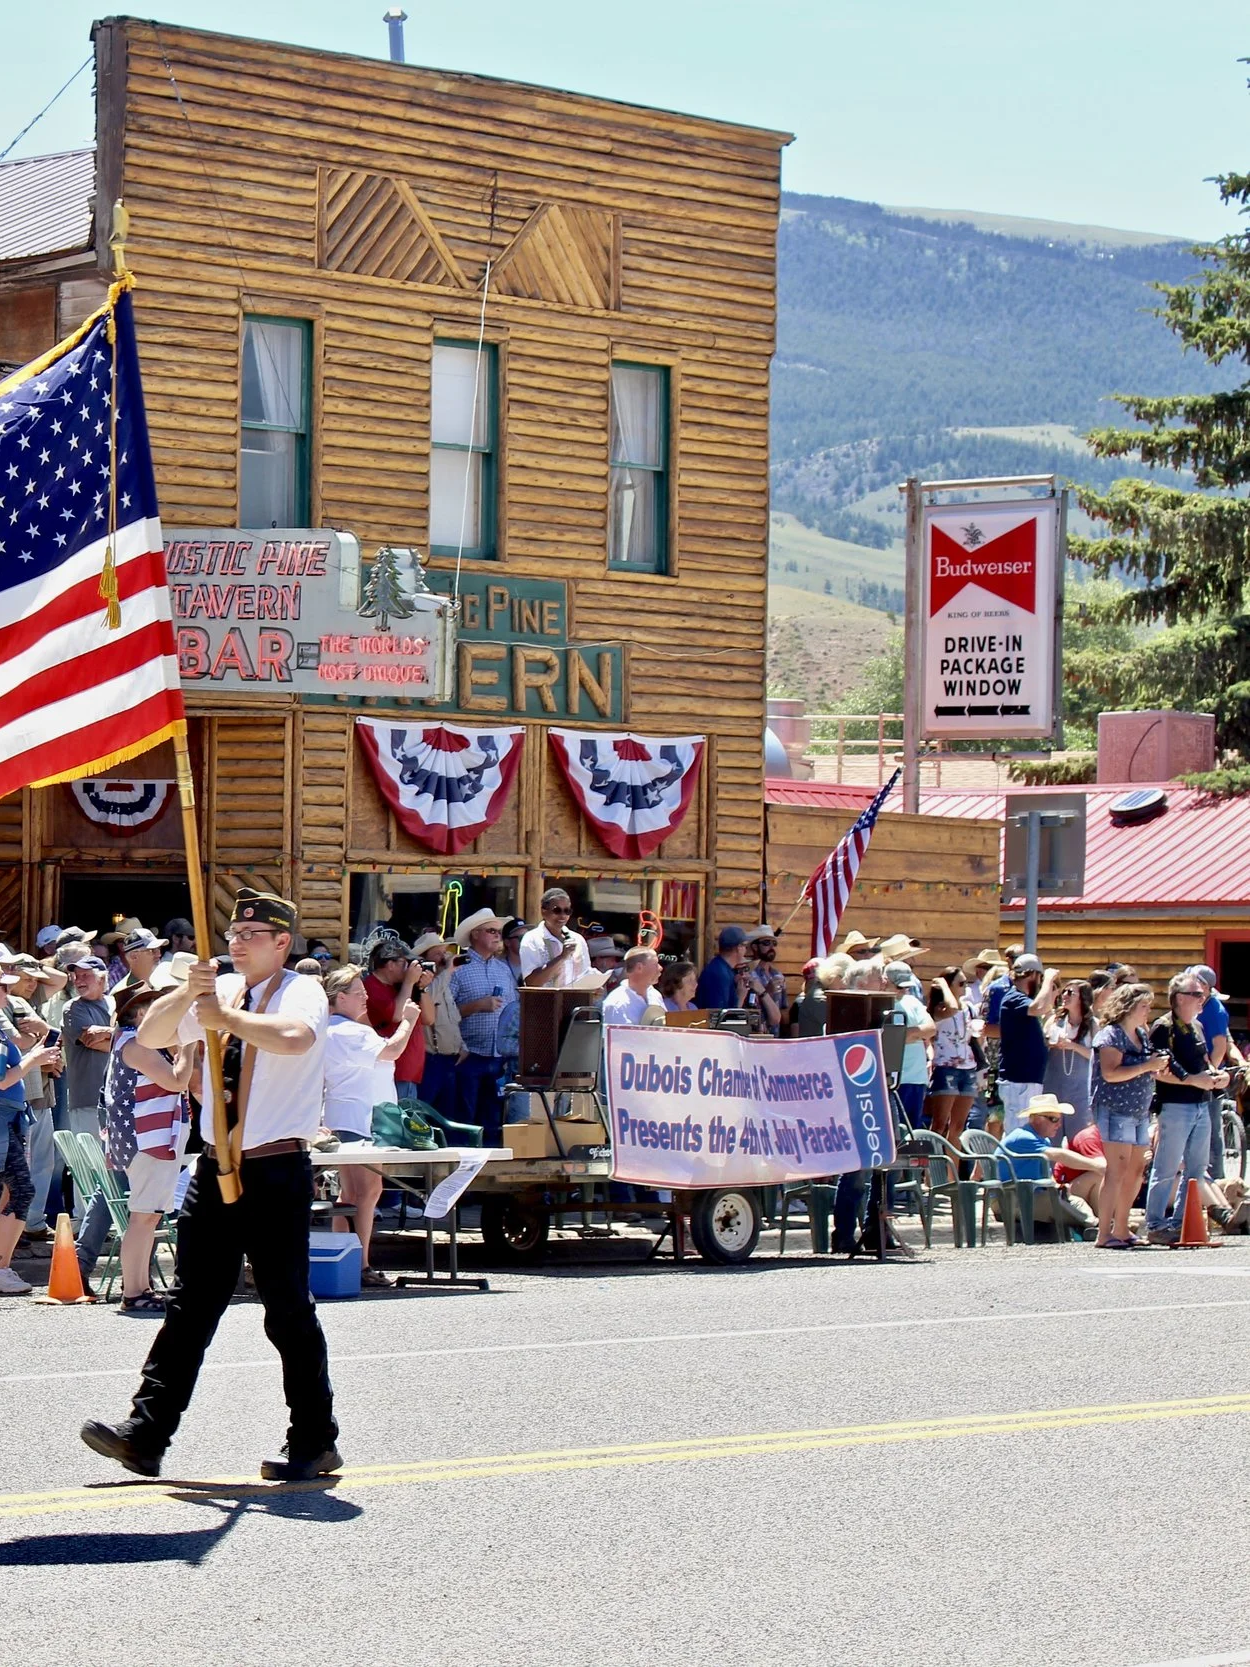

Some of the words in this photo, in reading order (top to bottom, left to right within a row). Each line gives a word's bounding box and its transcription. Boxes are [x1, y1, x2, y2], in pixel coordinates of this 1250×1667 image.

[163, 540, 253, 575] USTIC
[257, 540, 331, 576] PINE
[934, 556, 1032, 578] Budweiser
[173, 580, 302, 620] TAVERN
[487, 585, 561, 635] PINE
[947, 611, 968, 619] KING
[984, 609, 1010, 618] BEERS
[177, 626, 295, 682] BAR
[318, 634, 351, 654] THE
[945, 635, 1023, 654] DRIVE-IN
[318, 663, 356, 682] MOST
[335, 641, 613, 718] ERN
[940, 656, 1025, 675] PACKAGE
[943, 679, 1022, 697] WINDOW
[620, 1052, 692, 1095] Dubois
[760, 1065, 834, 1102] Commerce
[617, 1108, 703, 1153] Presents
[708, 1115, 736, 1155] the
[739, 1116, 762, 1155] 4th
[760, 1119, 774, 1156] of
[772, 1119, 802, 1164] July
[798, 1117, 851, 1151] Parade
[855, 1093, 883, 1167] pepsi
